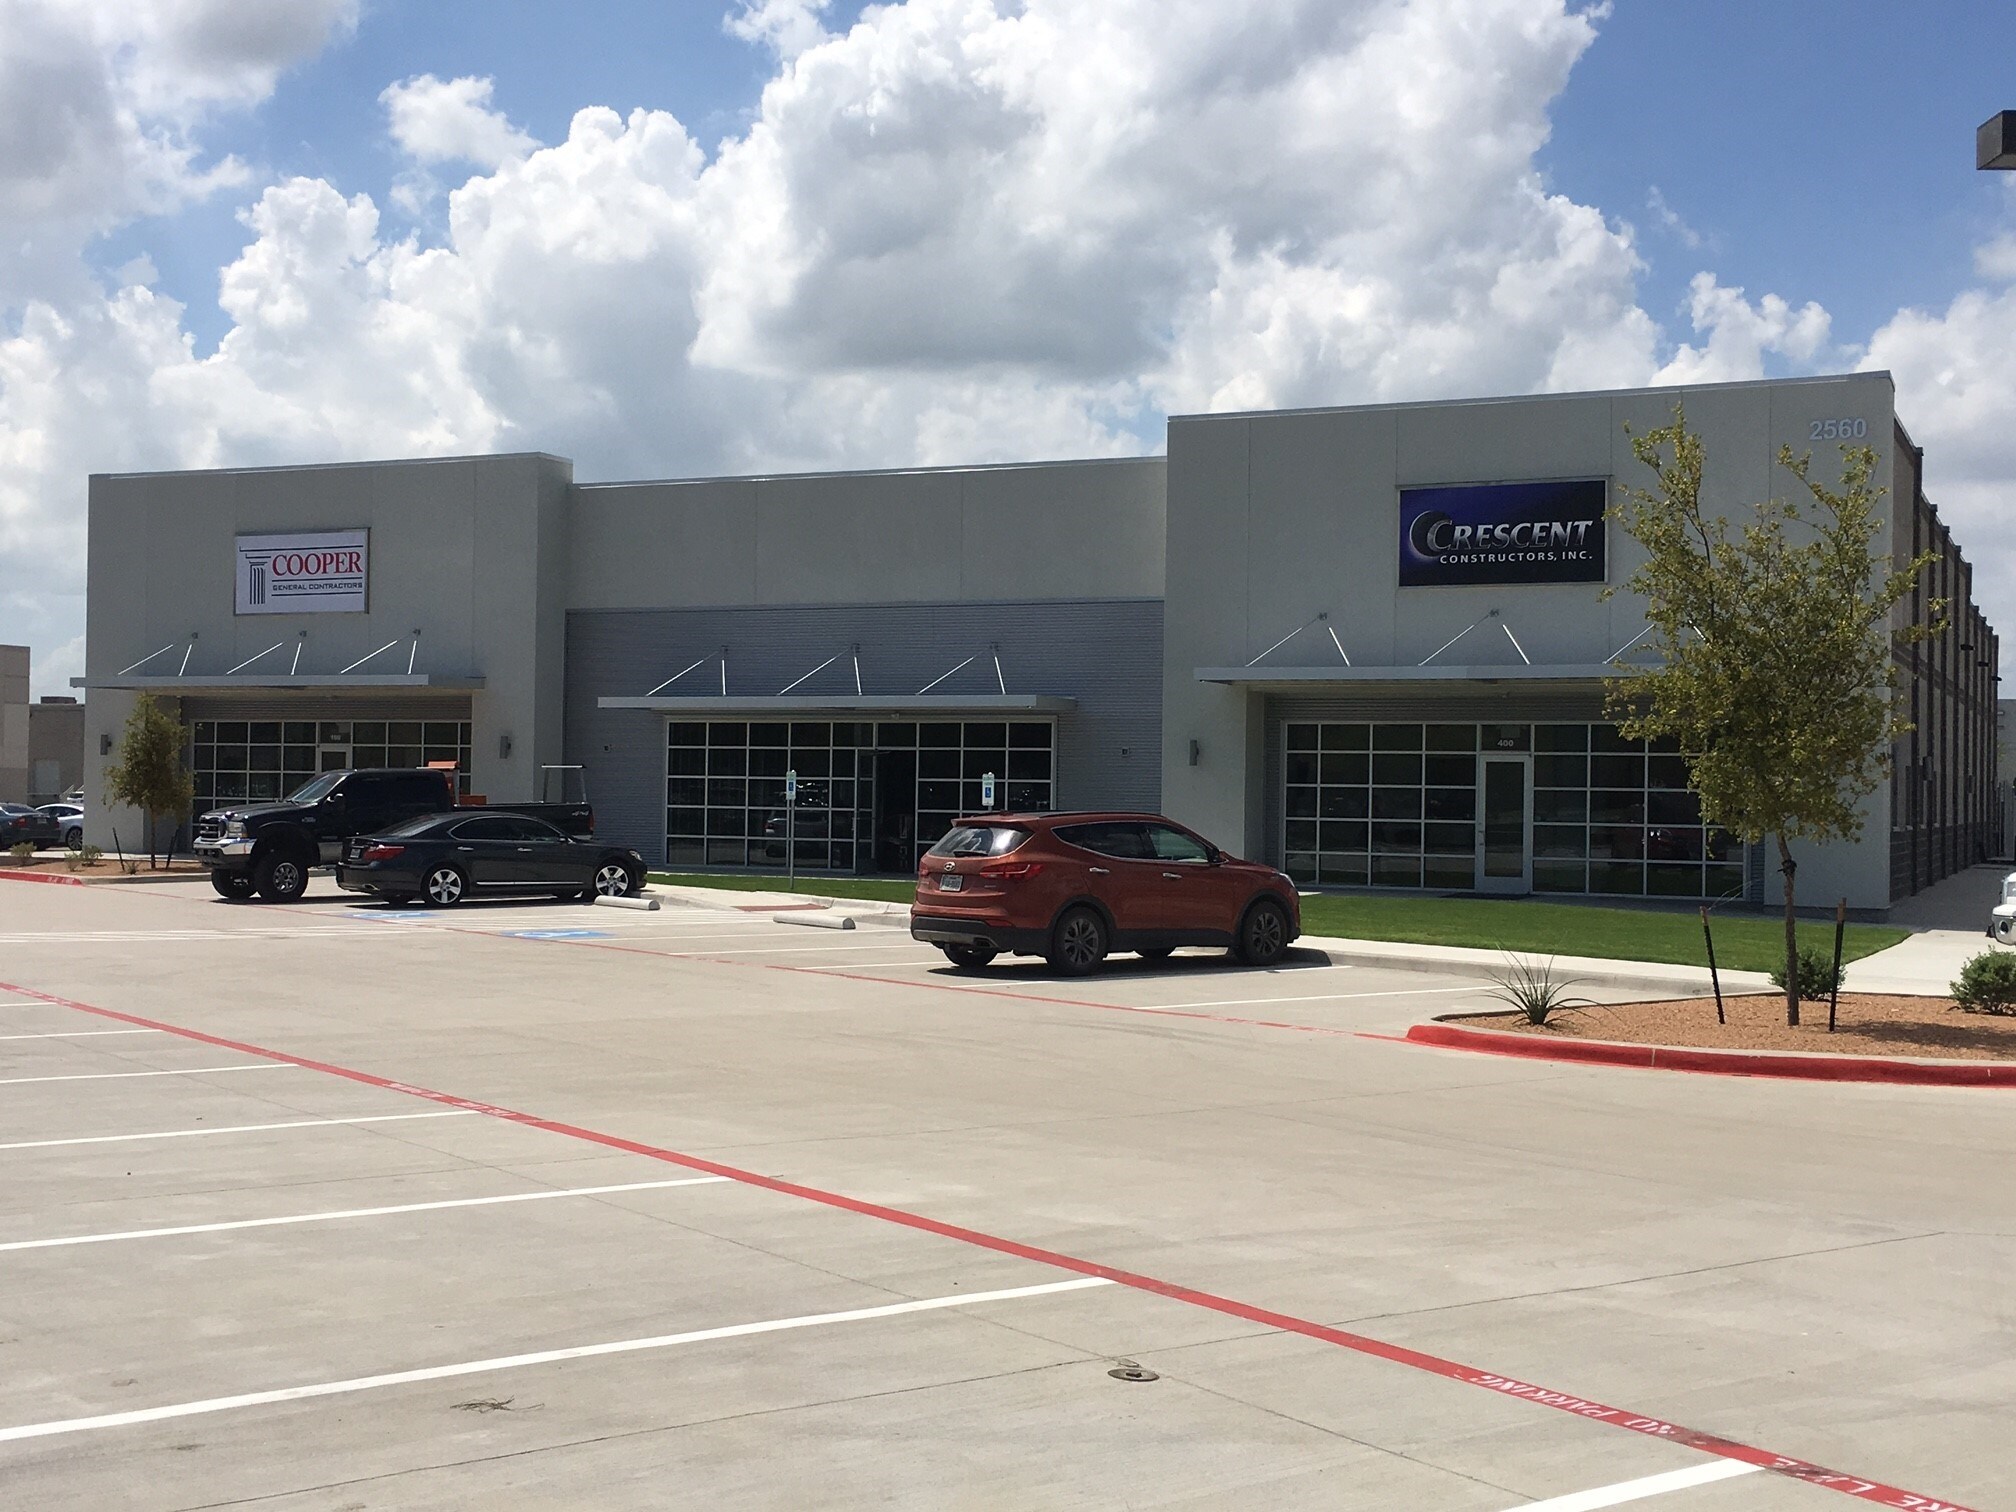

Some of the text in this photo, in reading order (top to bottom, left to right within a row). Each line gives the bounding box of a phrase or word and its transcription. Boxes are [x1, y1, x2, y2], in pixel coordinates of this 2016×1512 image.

[1808, 418, 1867, 440] 2560
[1426, 519, 1594, 551] CRESCENT
[272, 551, 364, 577] COOPER
[1439, 550, 1593, 564] CONSTRUCTORS, INC.
[272, 582, 363, 592] GENERAL CONTRACTORS
[1497, 739, 1514, 747] 400
[1469, 1375, 1620, 1417] PARKING
